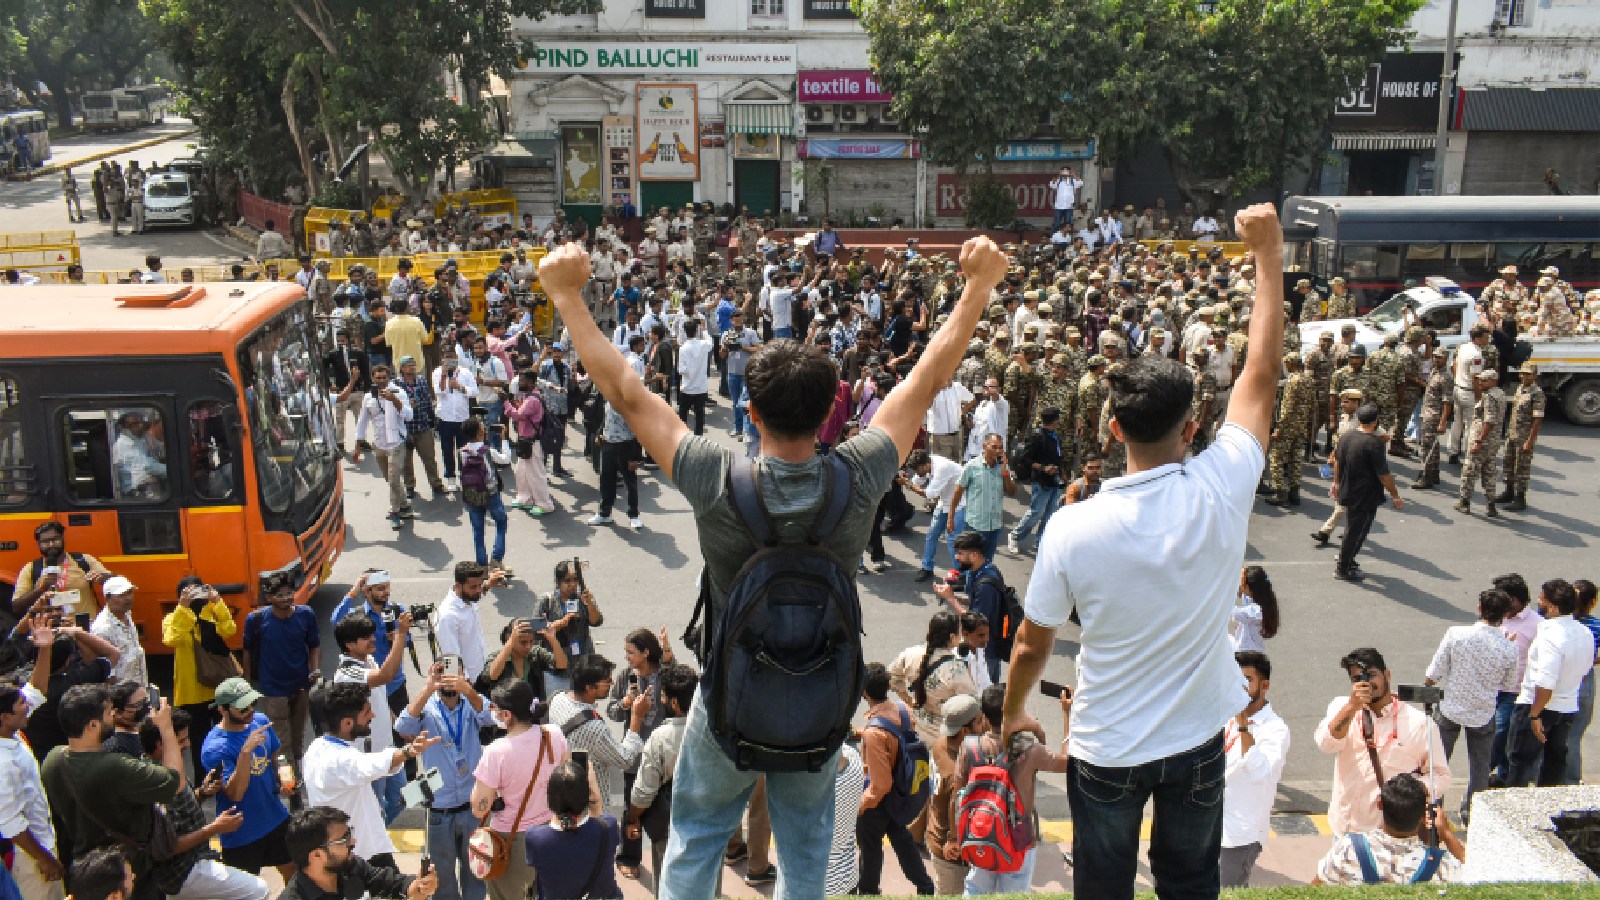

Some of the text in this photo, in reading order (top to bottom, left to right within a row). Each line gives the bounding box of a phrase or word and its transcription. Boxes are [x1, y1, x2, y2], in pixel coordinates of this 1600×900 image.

[536, 48, 699, 68] PIND BALLUCHI
[705, 55, 791, 63] RESTAURANT & BAR
[803, 78, 860, 94] textile
[1382, 81, 1420, 98] HOUSE
[1422, 81, 1438, 98] OF
